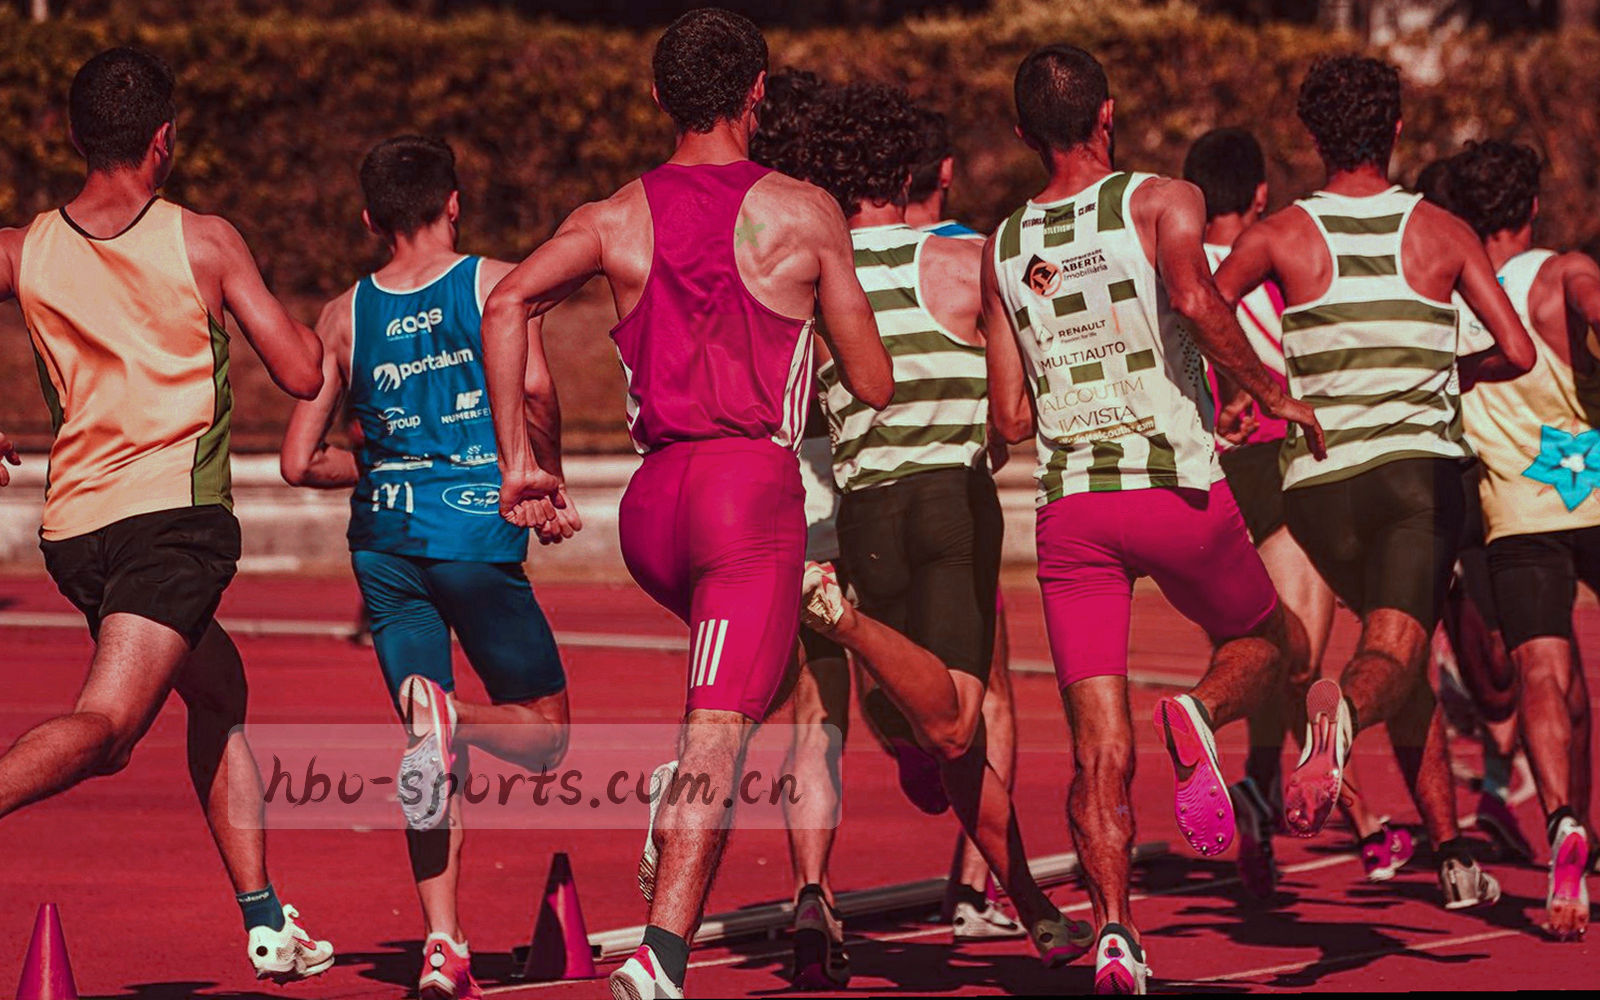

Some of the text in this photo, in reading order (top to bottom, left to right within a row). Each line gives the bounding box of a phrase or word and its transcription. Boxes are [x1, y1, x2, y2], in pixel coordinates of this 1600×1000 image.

[1062, 254, 1106, 273] ABERTA
[1058, 319, 1106, 338] RENAULT
[400, 348, 474, 380] portalum
[1040, 341, 1126, 371] MULTIAUTO
[456, 389, 482, 411] NF
[1042, 377, 1144, 415] ALCOUTIM
[386, 414, 421, 435] group
[441, 407, 492, 424] NUMERFE
